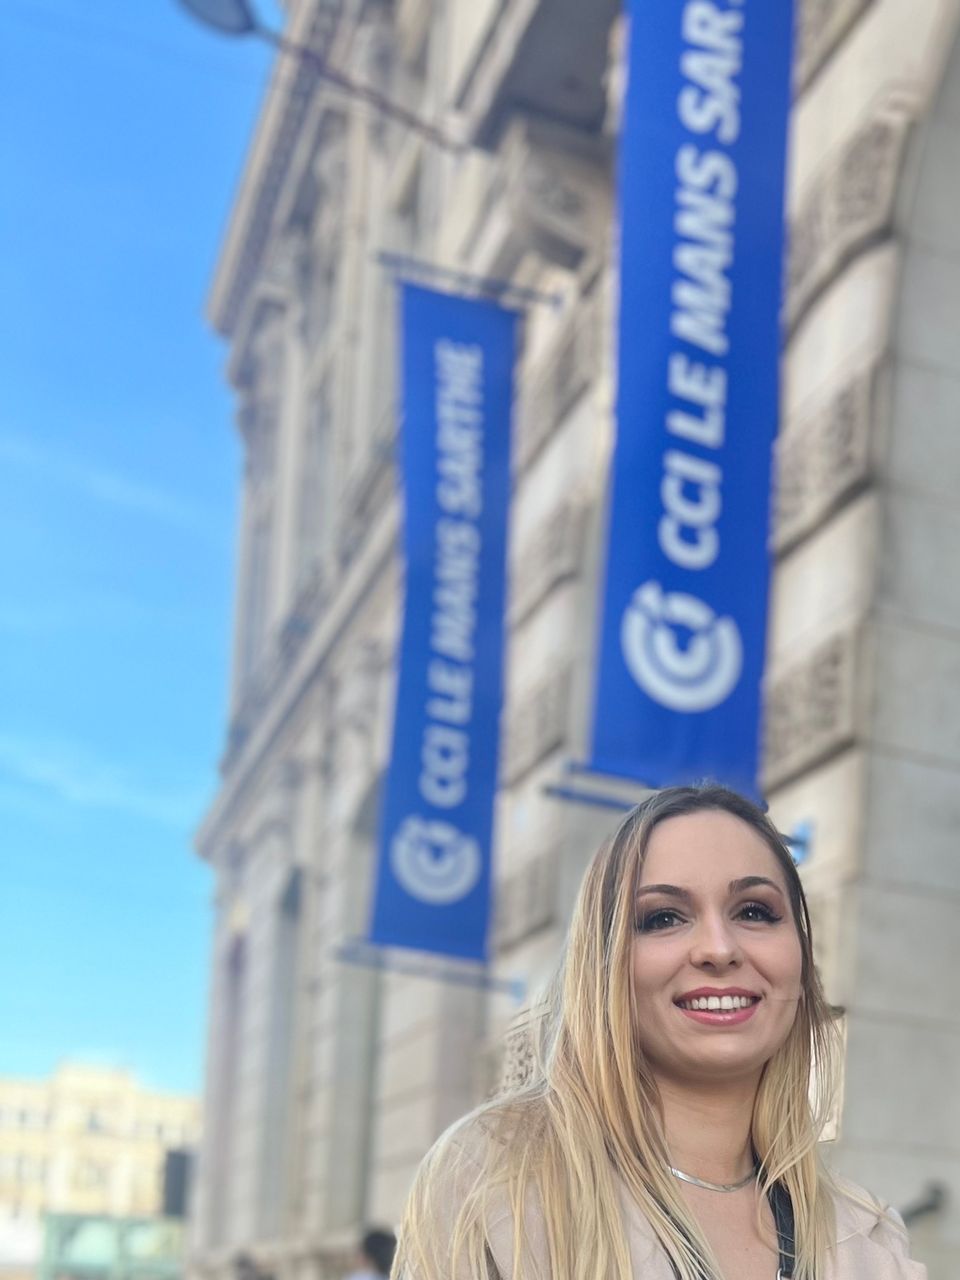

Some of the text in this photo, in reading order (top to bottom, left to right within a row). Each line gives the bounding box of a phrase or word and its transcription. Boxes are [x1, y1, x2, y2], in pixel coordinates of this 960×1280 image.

[659, 0, 745, 569] CCI LE MANS SAR
[420, 340, 482, 807] CCI LE MANS SARTHE
